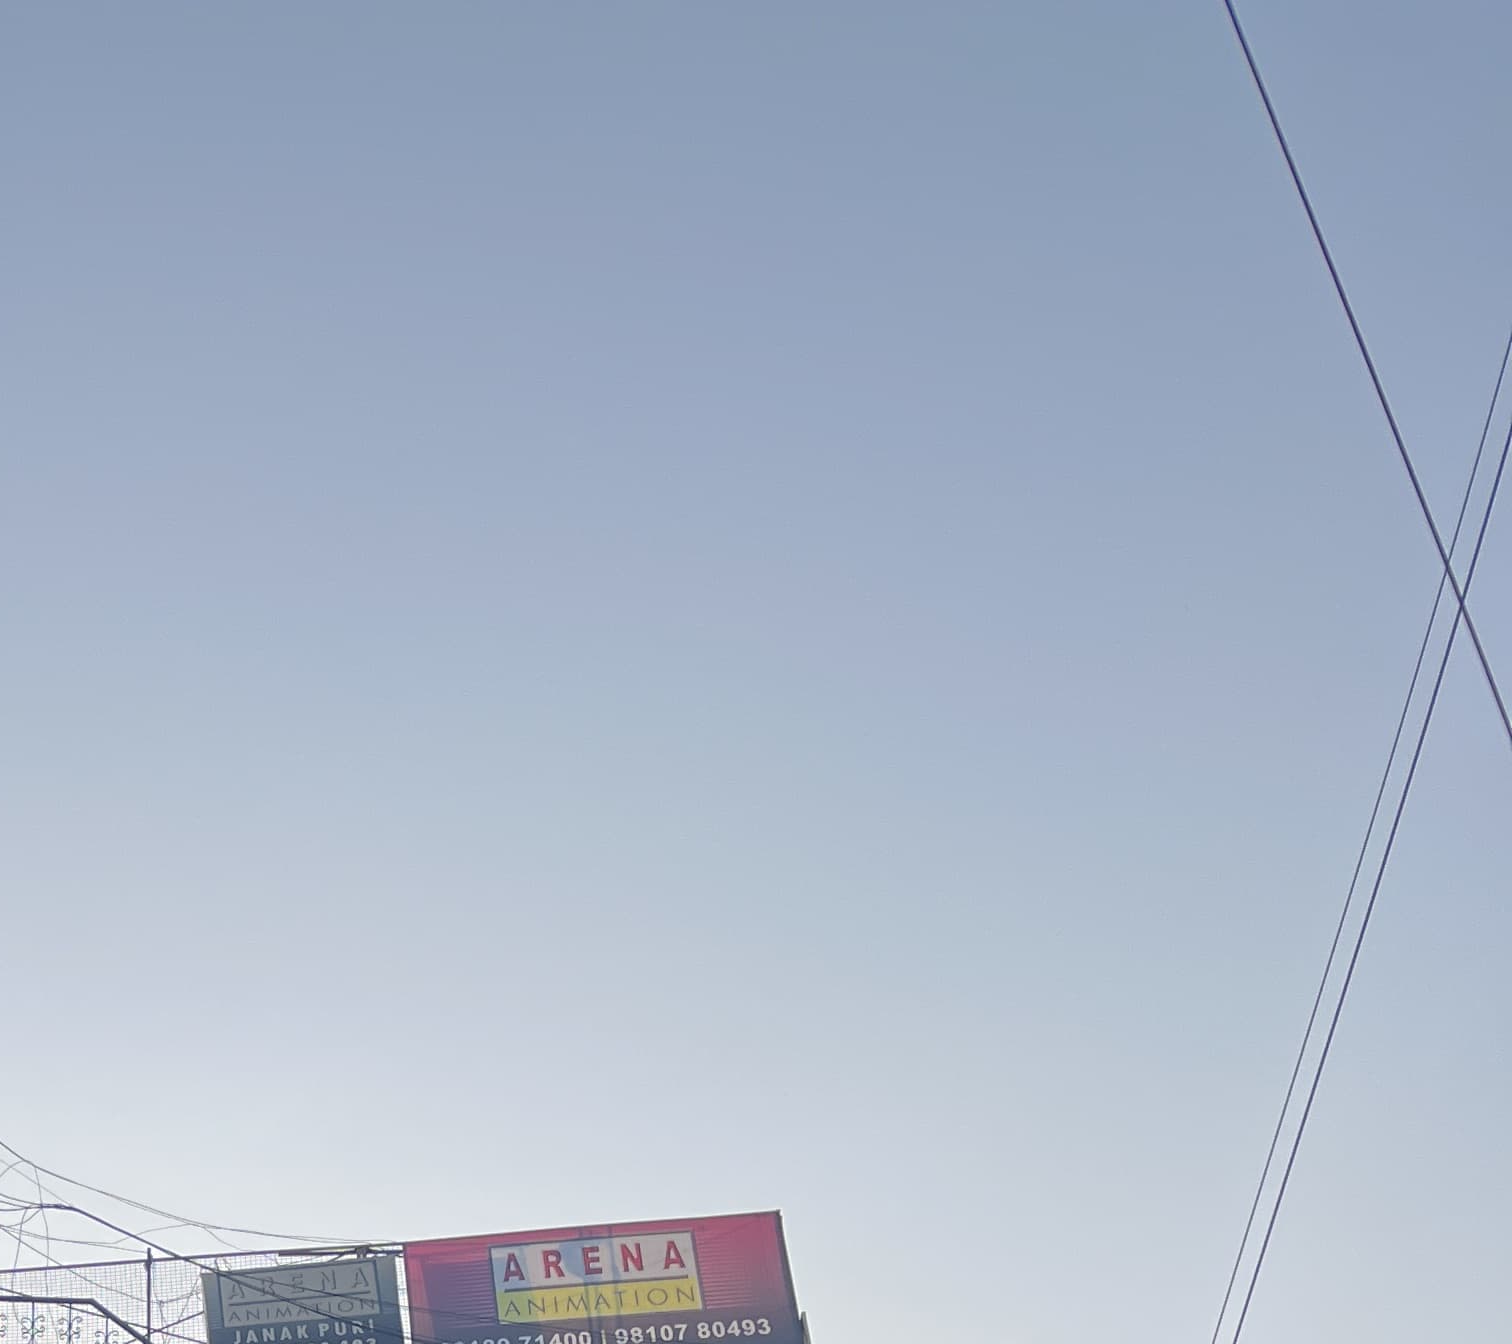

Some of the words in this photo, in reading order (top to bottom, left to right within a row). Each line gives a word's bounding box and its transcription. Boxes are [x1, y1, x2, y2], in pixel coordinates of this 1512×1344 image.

[503, 1239, 686, 1283] ARENA
[504, 1285, 696, 1318] ANIMATION
[233, 1323, 311, 1344] JANAK
[318, 1320, 375, 1337] PURI
[615, 1324, 688, 1344] 98107
[697, 1318, 771, 1338] 80493
